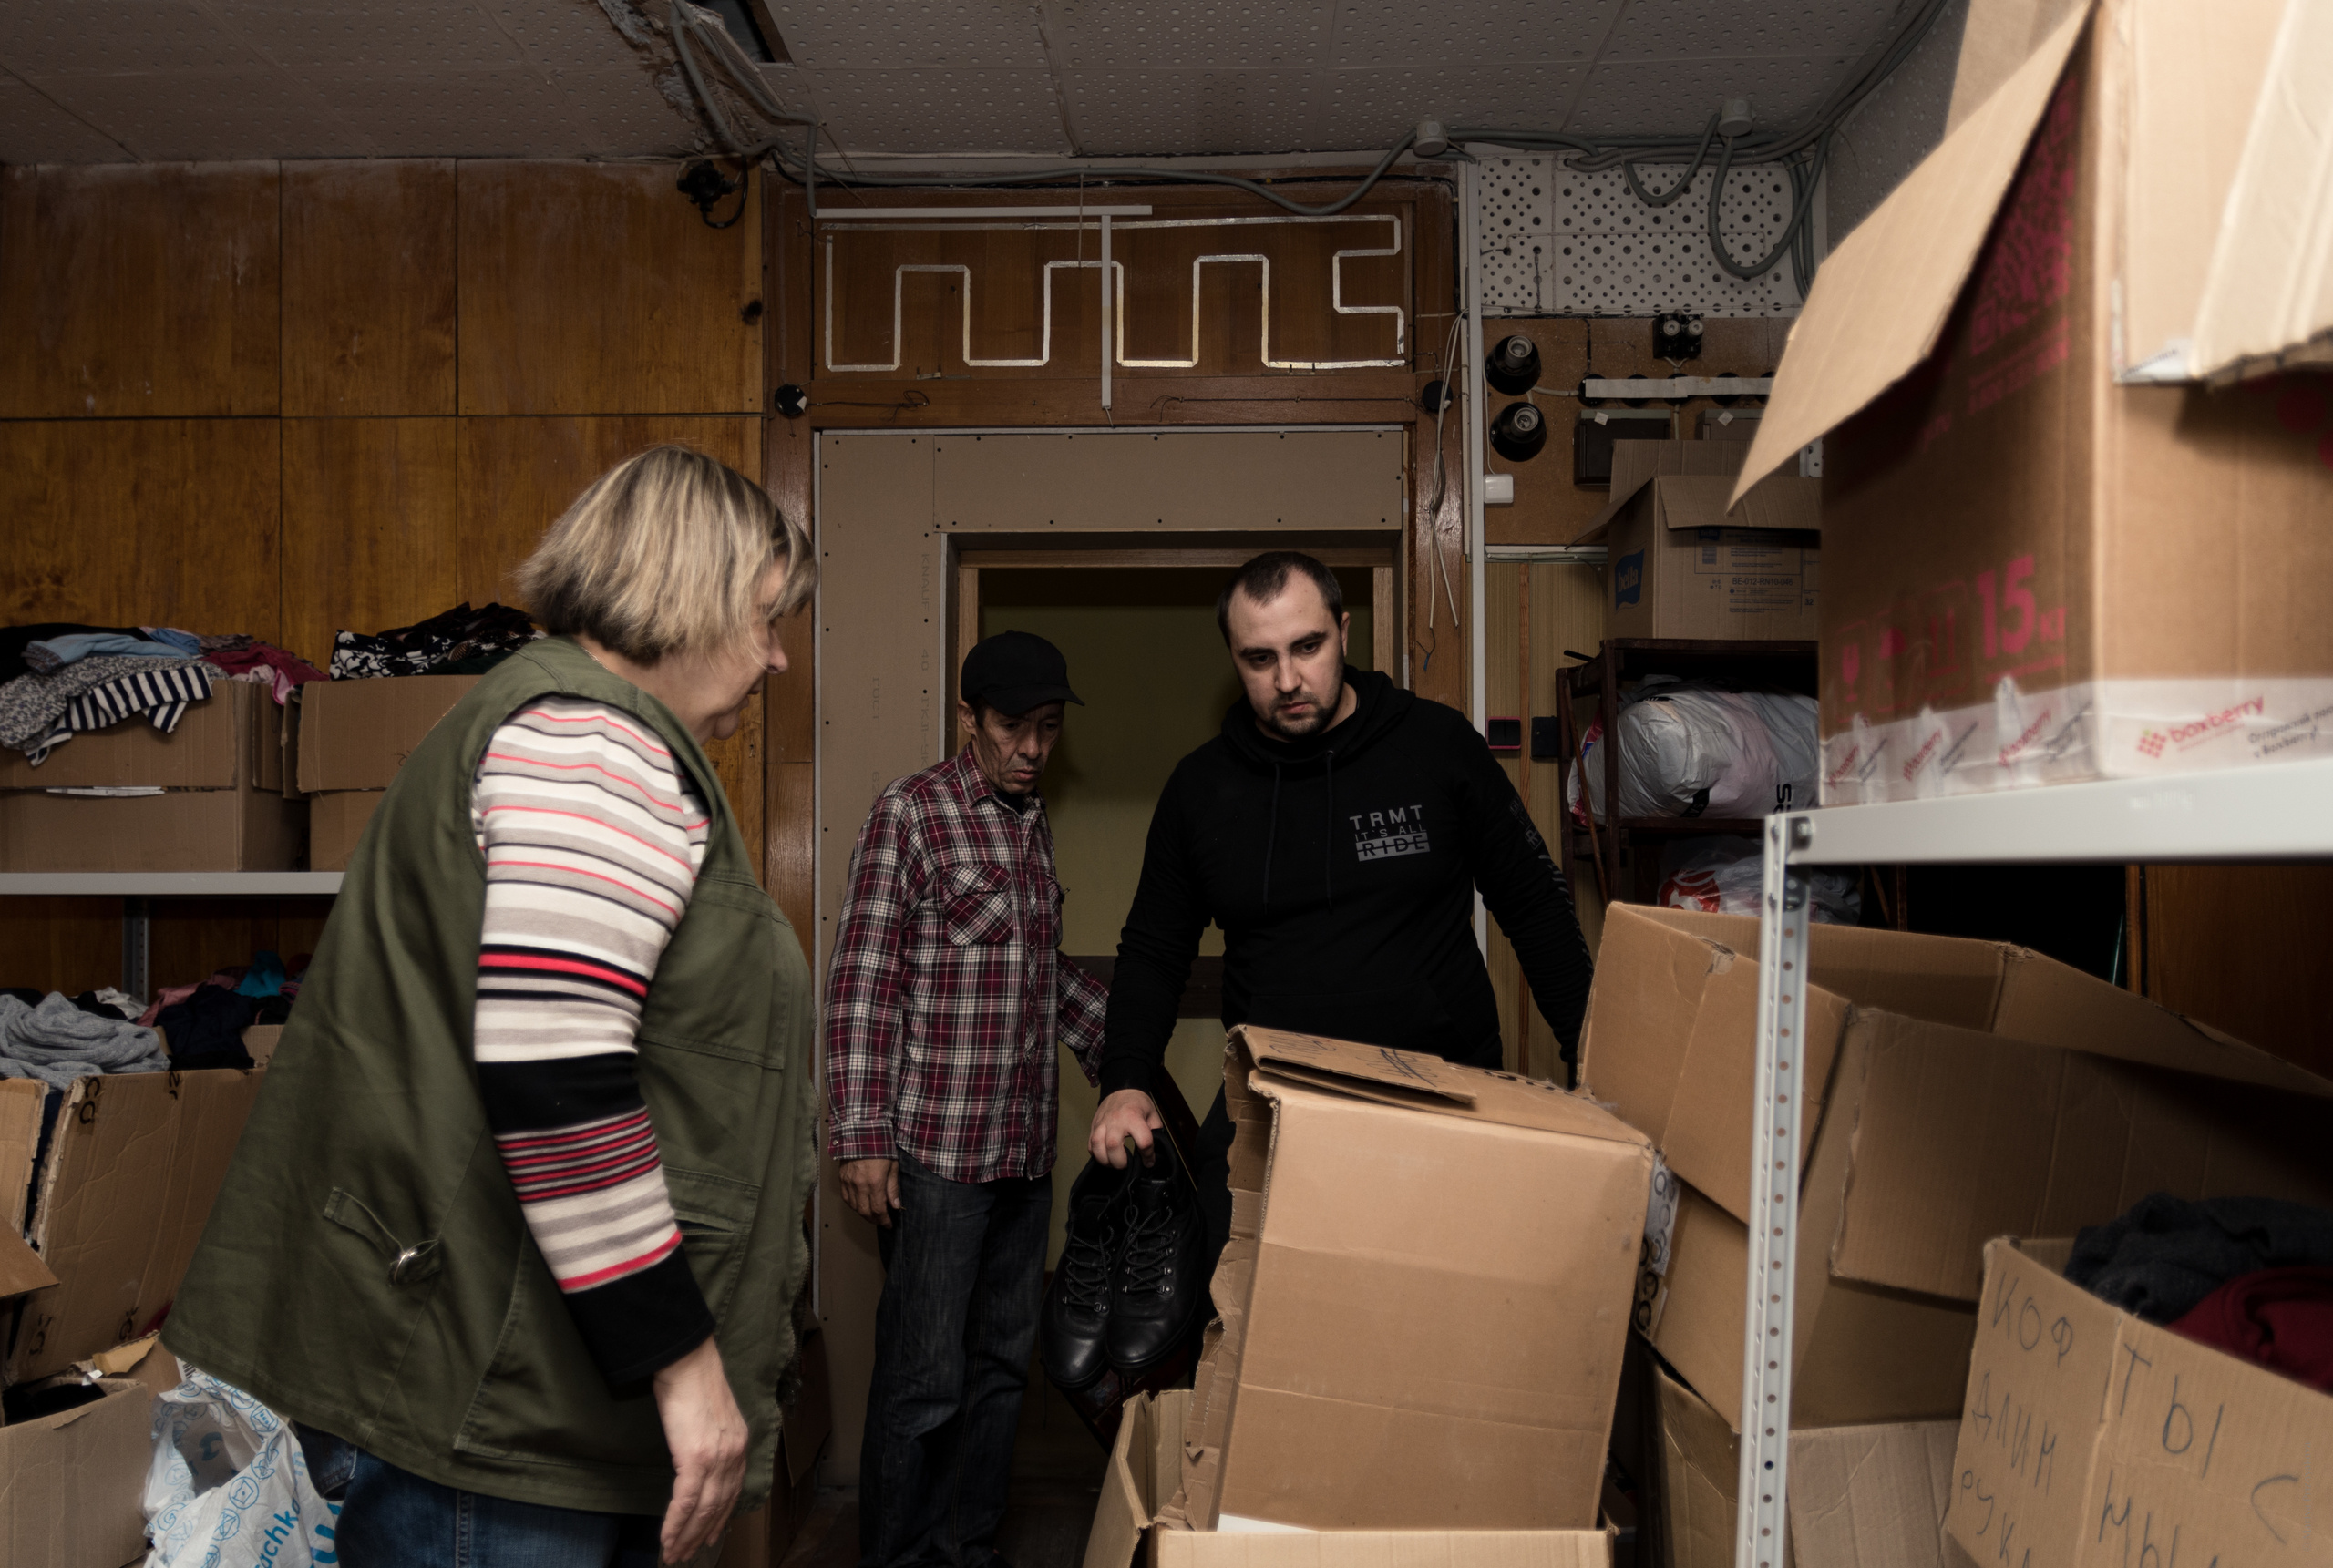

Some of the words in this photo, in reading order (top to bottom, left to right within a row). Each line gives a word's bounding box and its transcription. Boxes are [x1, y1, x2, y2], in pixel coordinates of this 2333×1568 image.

[1618, 566, 1639, 593] bella
[1804, 598, 1814, 606] 32
[1977, 554, 2036, 660] 15
[1349, 804, 1423, 831] TRMT
[1398, 823, 1427, 835] ALL
[1362, 835, 1426, 857] RIDE
